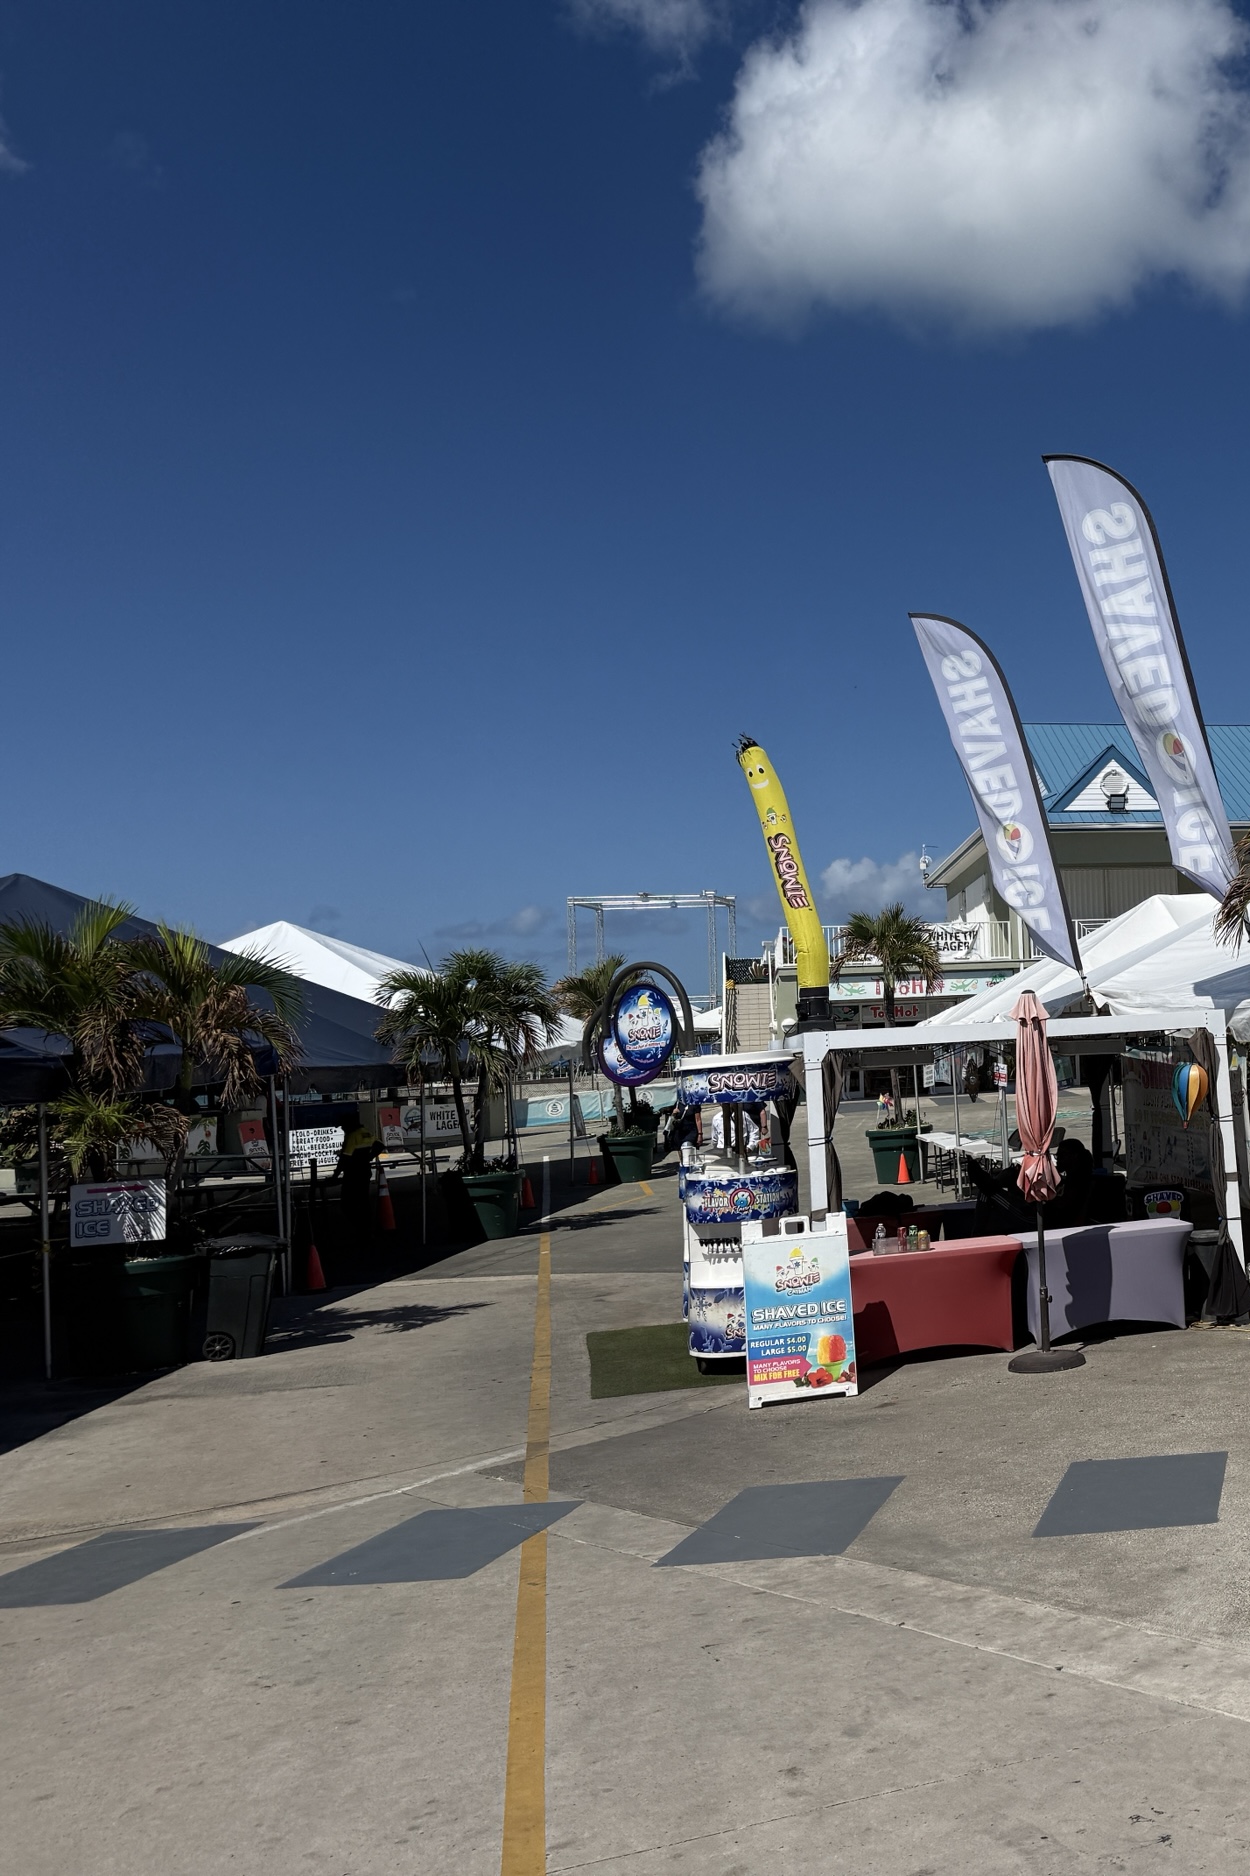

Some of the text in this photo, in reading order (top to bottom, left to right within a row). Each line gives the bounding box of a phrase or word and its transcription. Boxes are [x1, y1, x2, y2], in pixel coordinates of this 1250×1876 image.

[767, 833, 810, 909] SNOWIE
[929, 931, 961, 942] WHITE
[936, 941, 970, 952] LAGER
[628, 1026, 661, 1043] SNOWIE
[708, 1069, 777, 1094] SNOWIE
[430, 1110, 456, 1120] WHITE
[436, 1120, 461, 1131] LAGE
[704, 1196, 729, 1208] FLAVOR
[756, 1192, 780, 1204] STATION
[1146, 1192, 1181, 1205] SHAVED
[75, 1220, 110, 1239] ICE
[776, 1272, 821, 1292] SNOWIE
[787, 1286, 812, 1296] CAYMAN
[752, 1300, 847, 1324] SHAVED ICE
[753, 1323, 774, 1331] MANY
[774, 1320, 807, 1329] FLAVORS
[817, 1314, 847, 1323] CHOOSE!
[750, 1336, 806, 1348] REGULAR $4.00
[761, 1345, 807, 1356] LARGE $5.00
[763, 1365, 787, 1373] CHOOSE
[772, 1359, 801, 1367] FLAVORS
[753, 1369, 801, 1382] MIX FOR FREE
